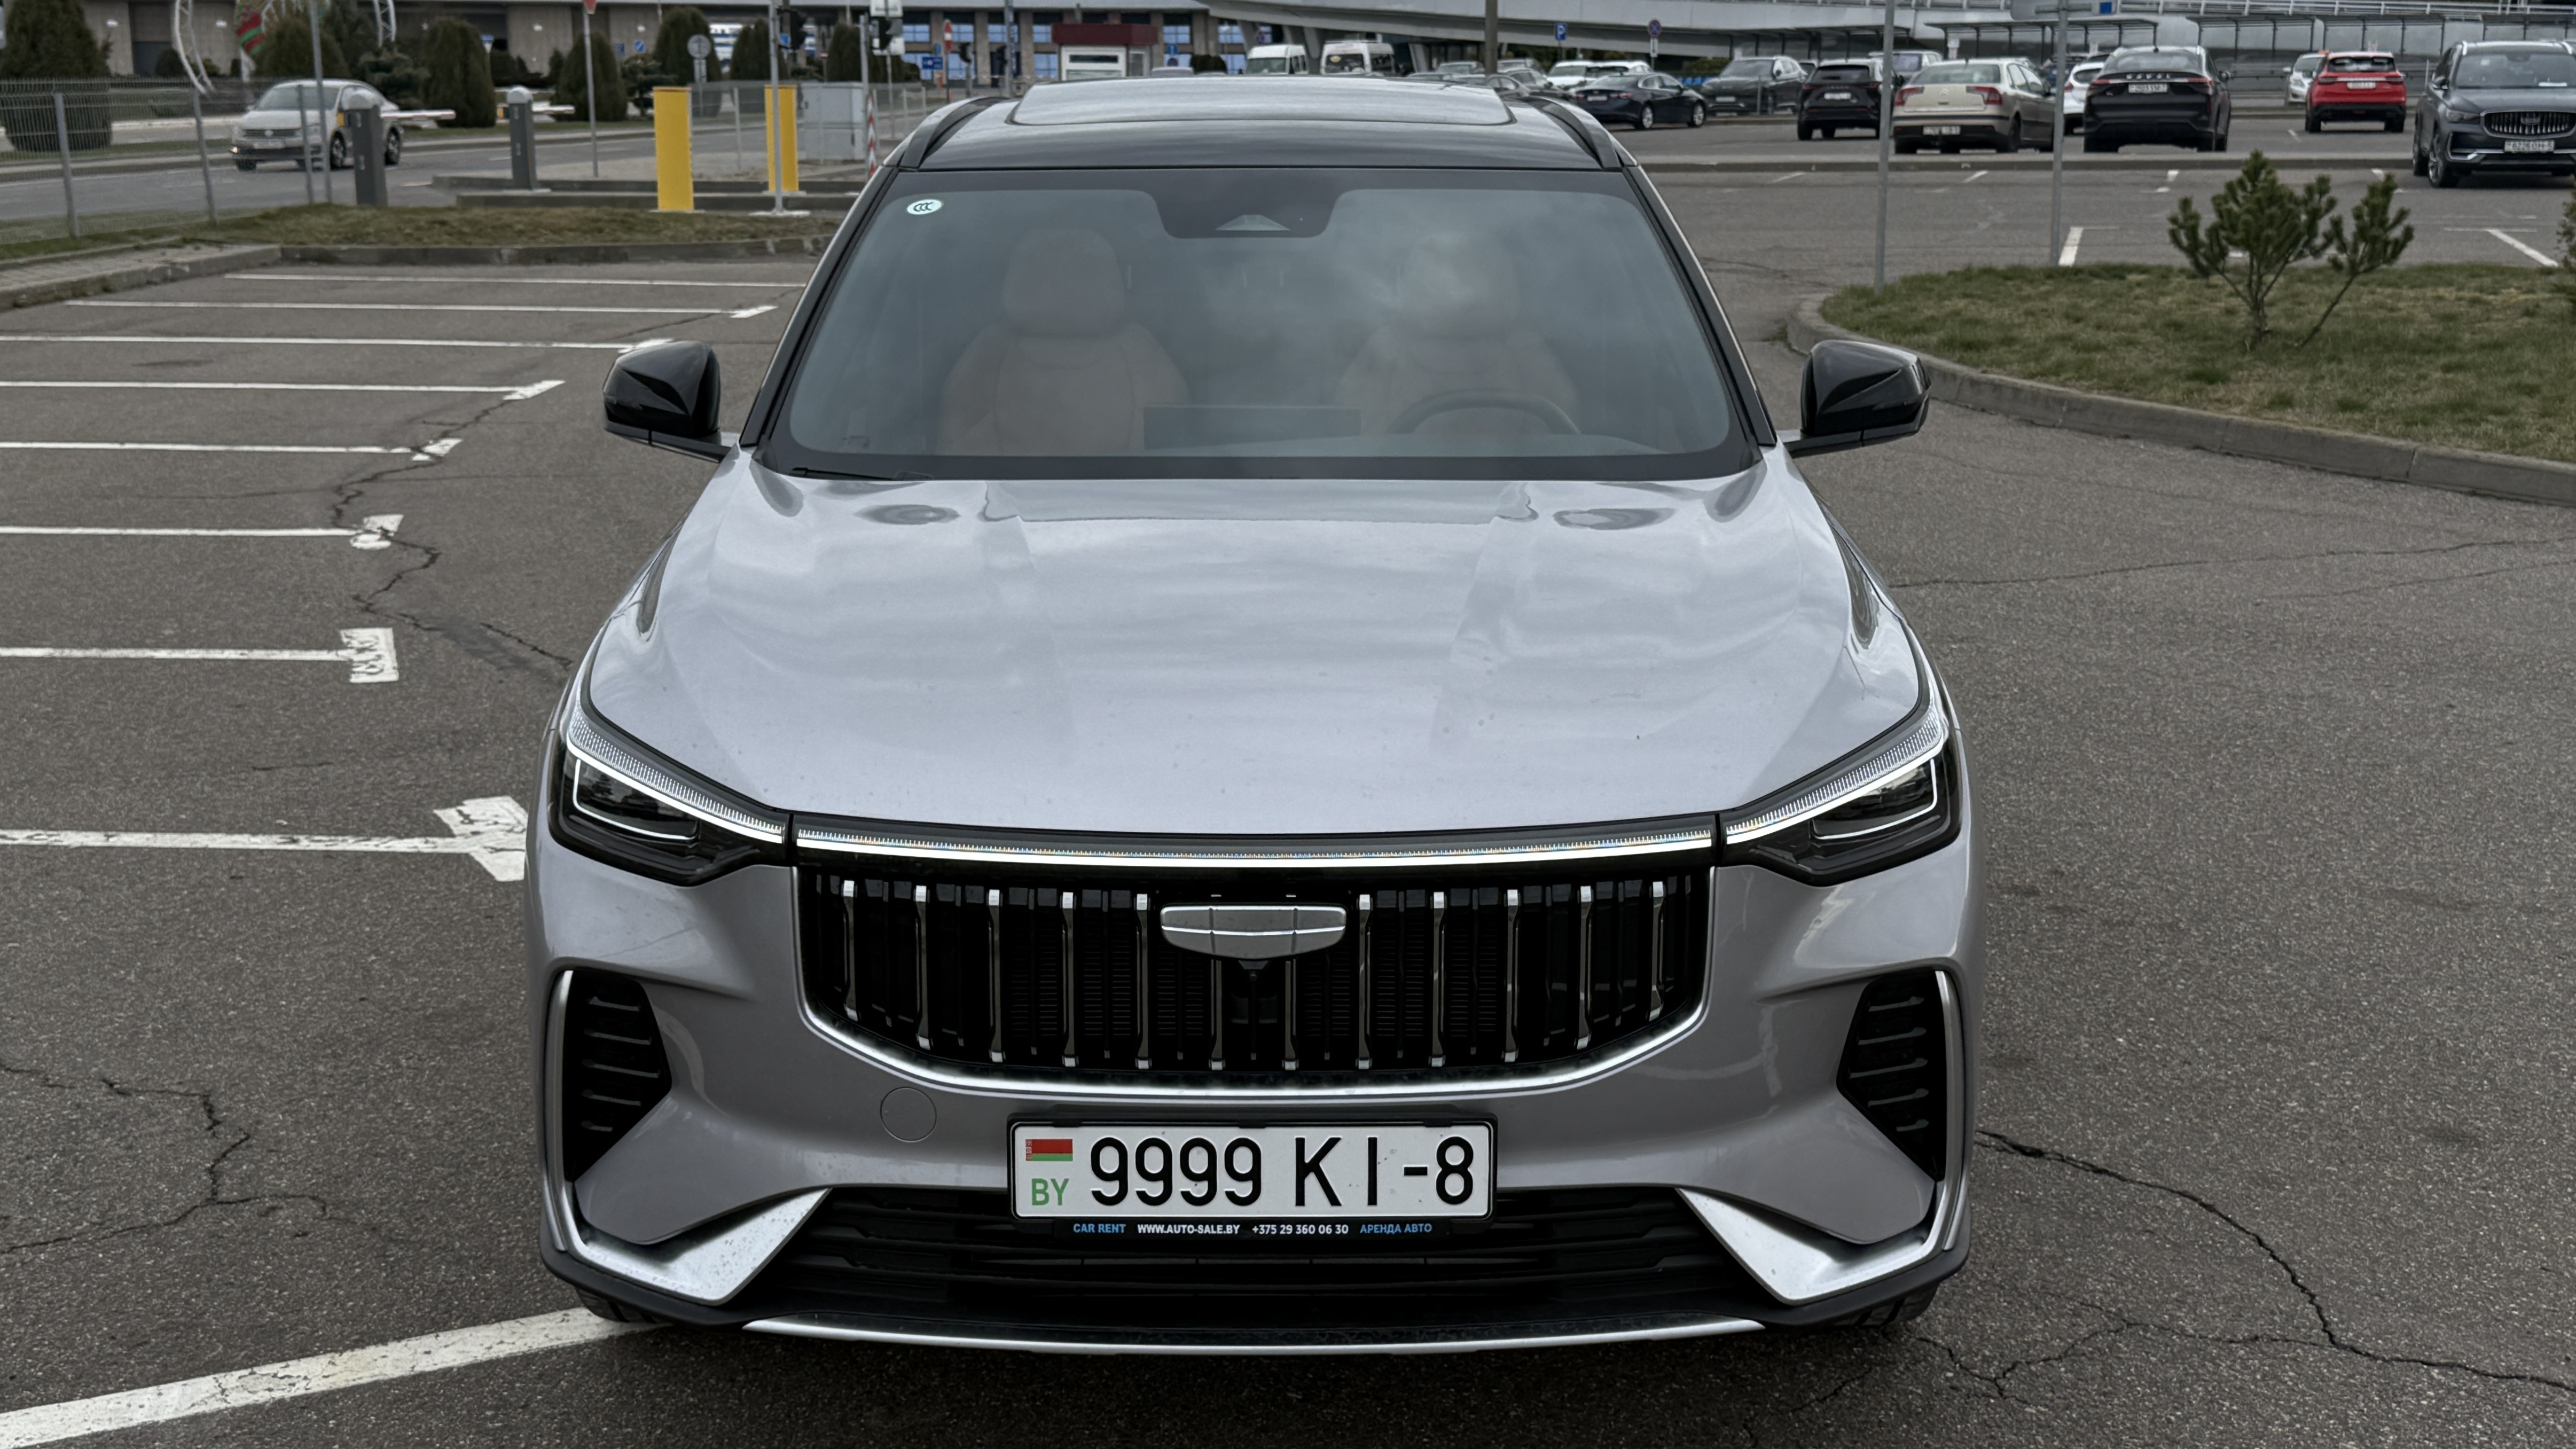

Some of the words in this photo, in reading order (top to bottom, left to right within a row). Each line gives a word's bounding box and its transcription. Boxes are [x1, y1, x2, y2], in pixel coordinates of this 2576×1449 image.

[1090, 1137, 1262, 1207] 9999
[1031, 1178, 1070, 1206] BY
[1073, 1223, 1095, 1233] CAR
[1098, 1224, 1126, 1234] RENT
[1137, 1224, 1241, 1234] WWW.AUTO-SALE.BY
[1252, 1224, 1277, 1234] +375
[1280, 1224, 1293, 1234] 29
[1295, 1224, 1316, 1234] 360
[1318, 1224, 1333, 1234] 06
[1335, 1224, 1349, 1234] 30
[1360, 1224, 1401, 1234] АРЕНДА
[1404, 1223, 1432, 1233] АВТО
